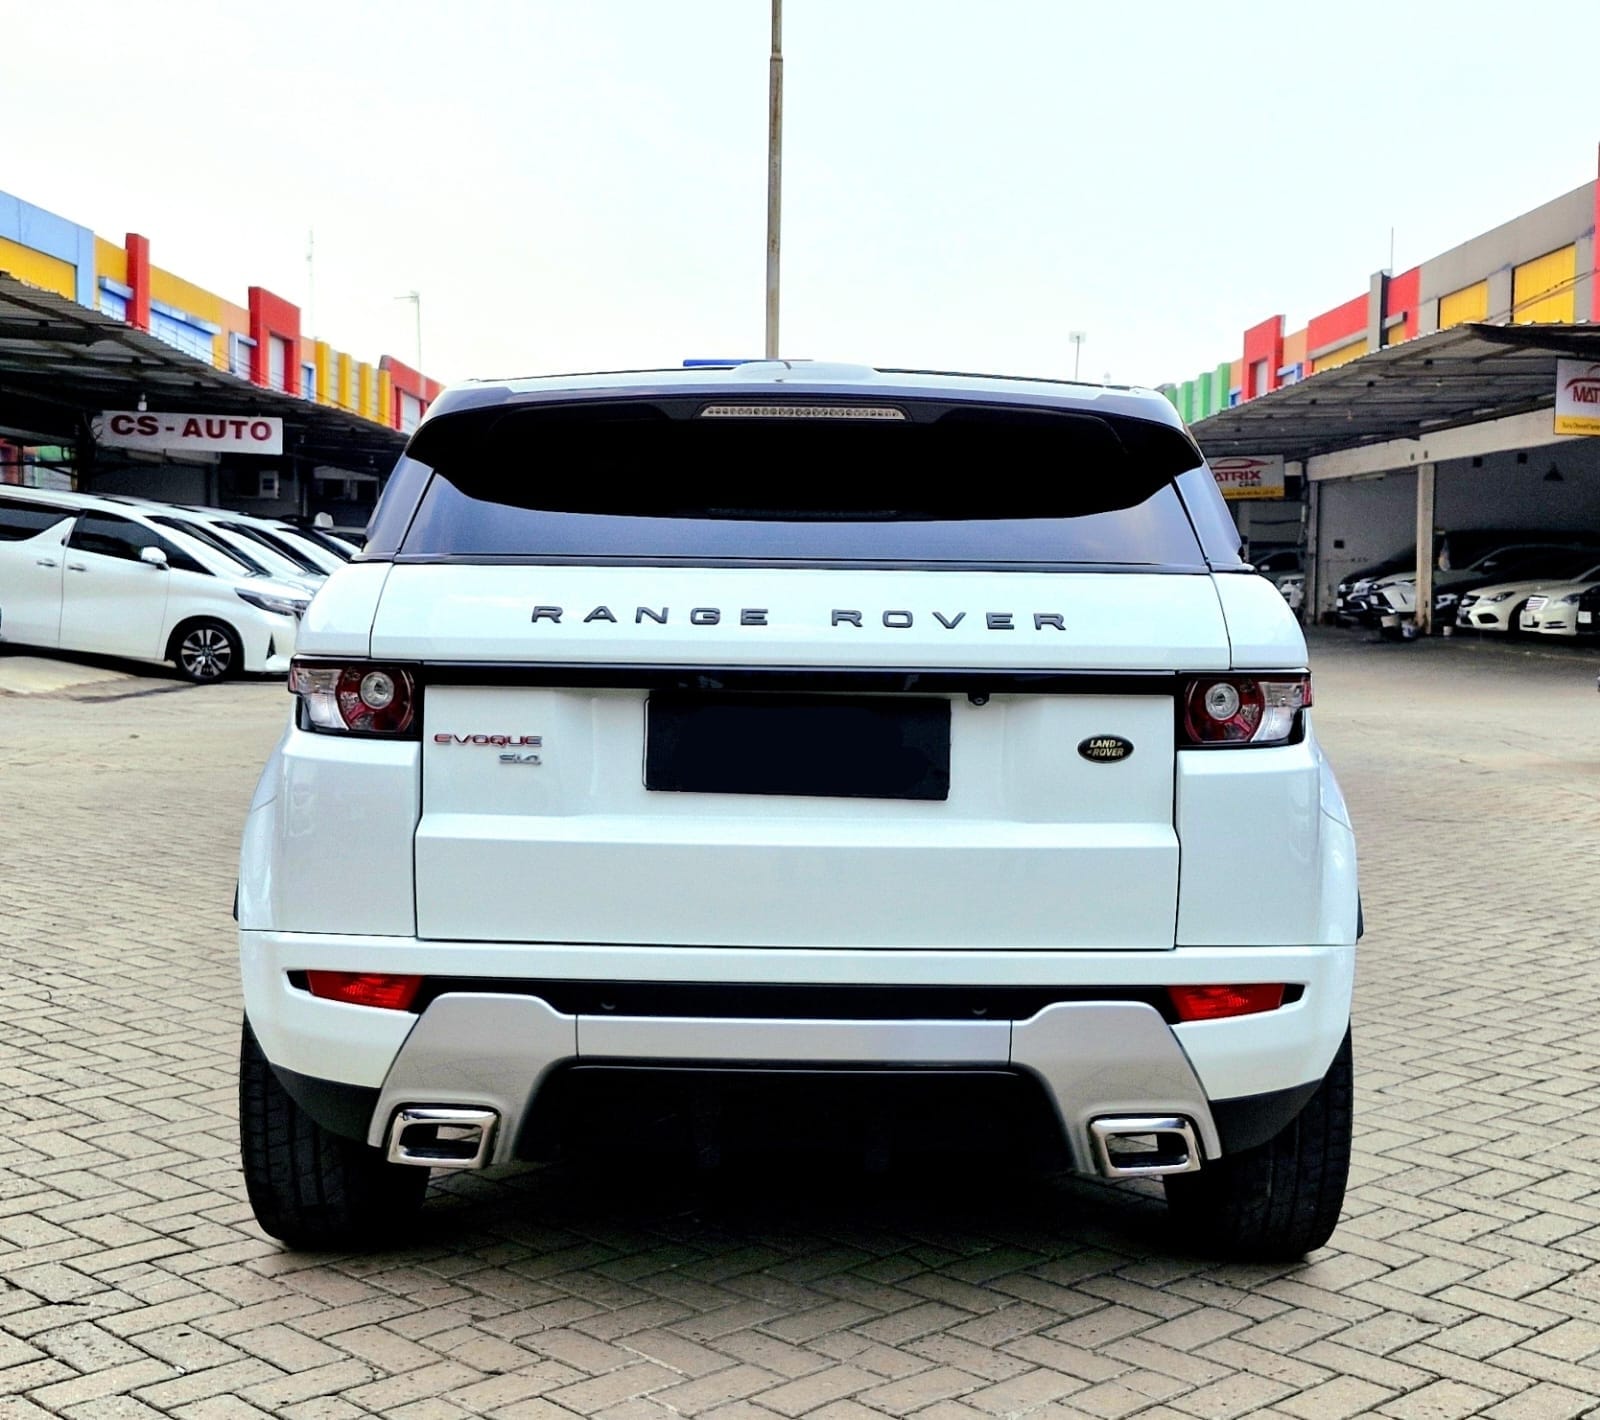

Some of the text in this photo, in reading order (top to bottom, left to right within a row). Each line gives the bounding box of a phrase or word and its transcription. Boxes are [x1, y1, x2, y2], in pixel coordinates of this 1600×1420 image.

[1214, 470, 1261, 482] ATRIX
[532, 605, 1067, 631] RANGE ROVER
[434, 733, 542, 748] EVOQUE
[1090, 739, 1116, 748] LAND
[1092, 748, 1124, 757] ROVER
